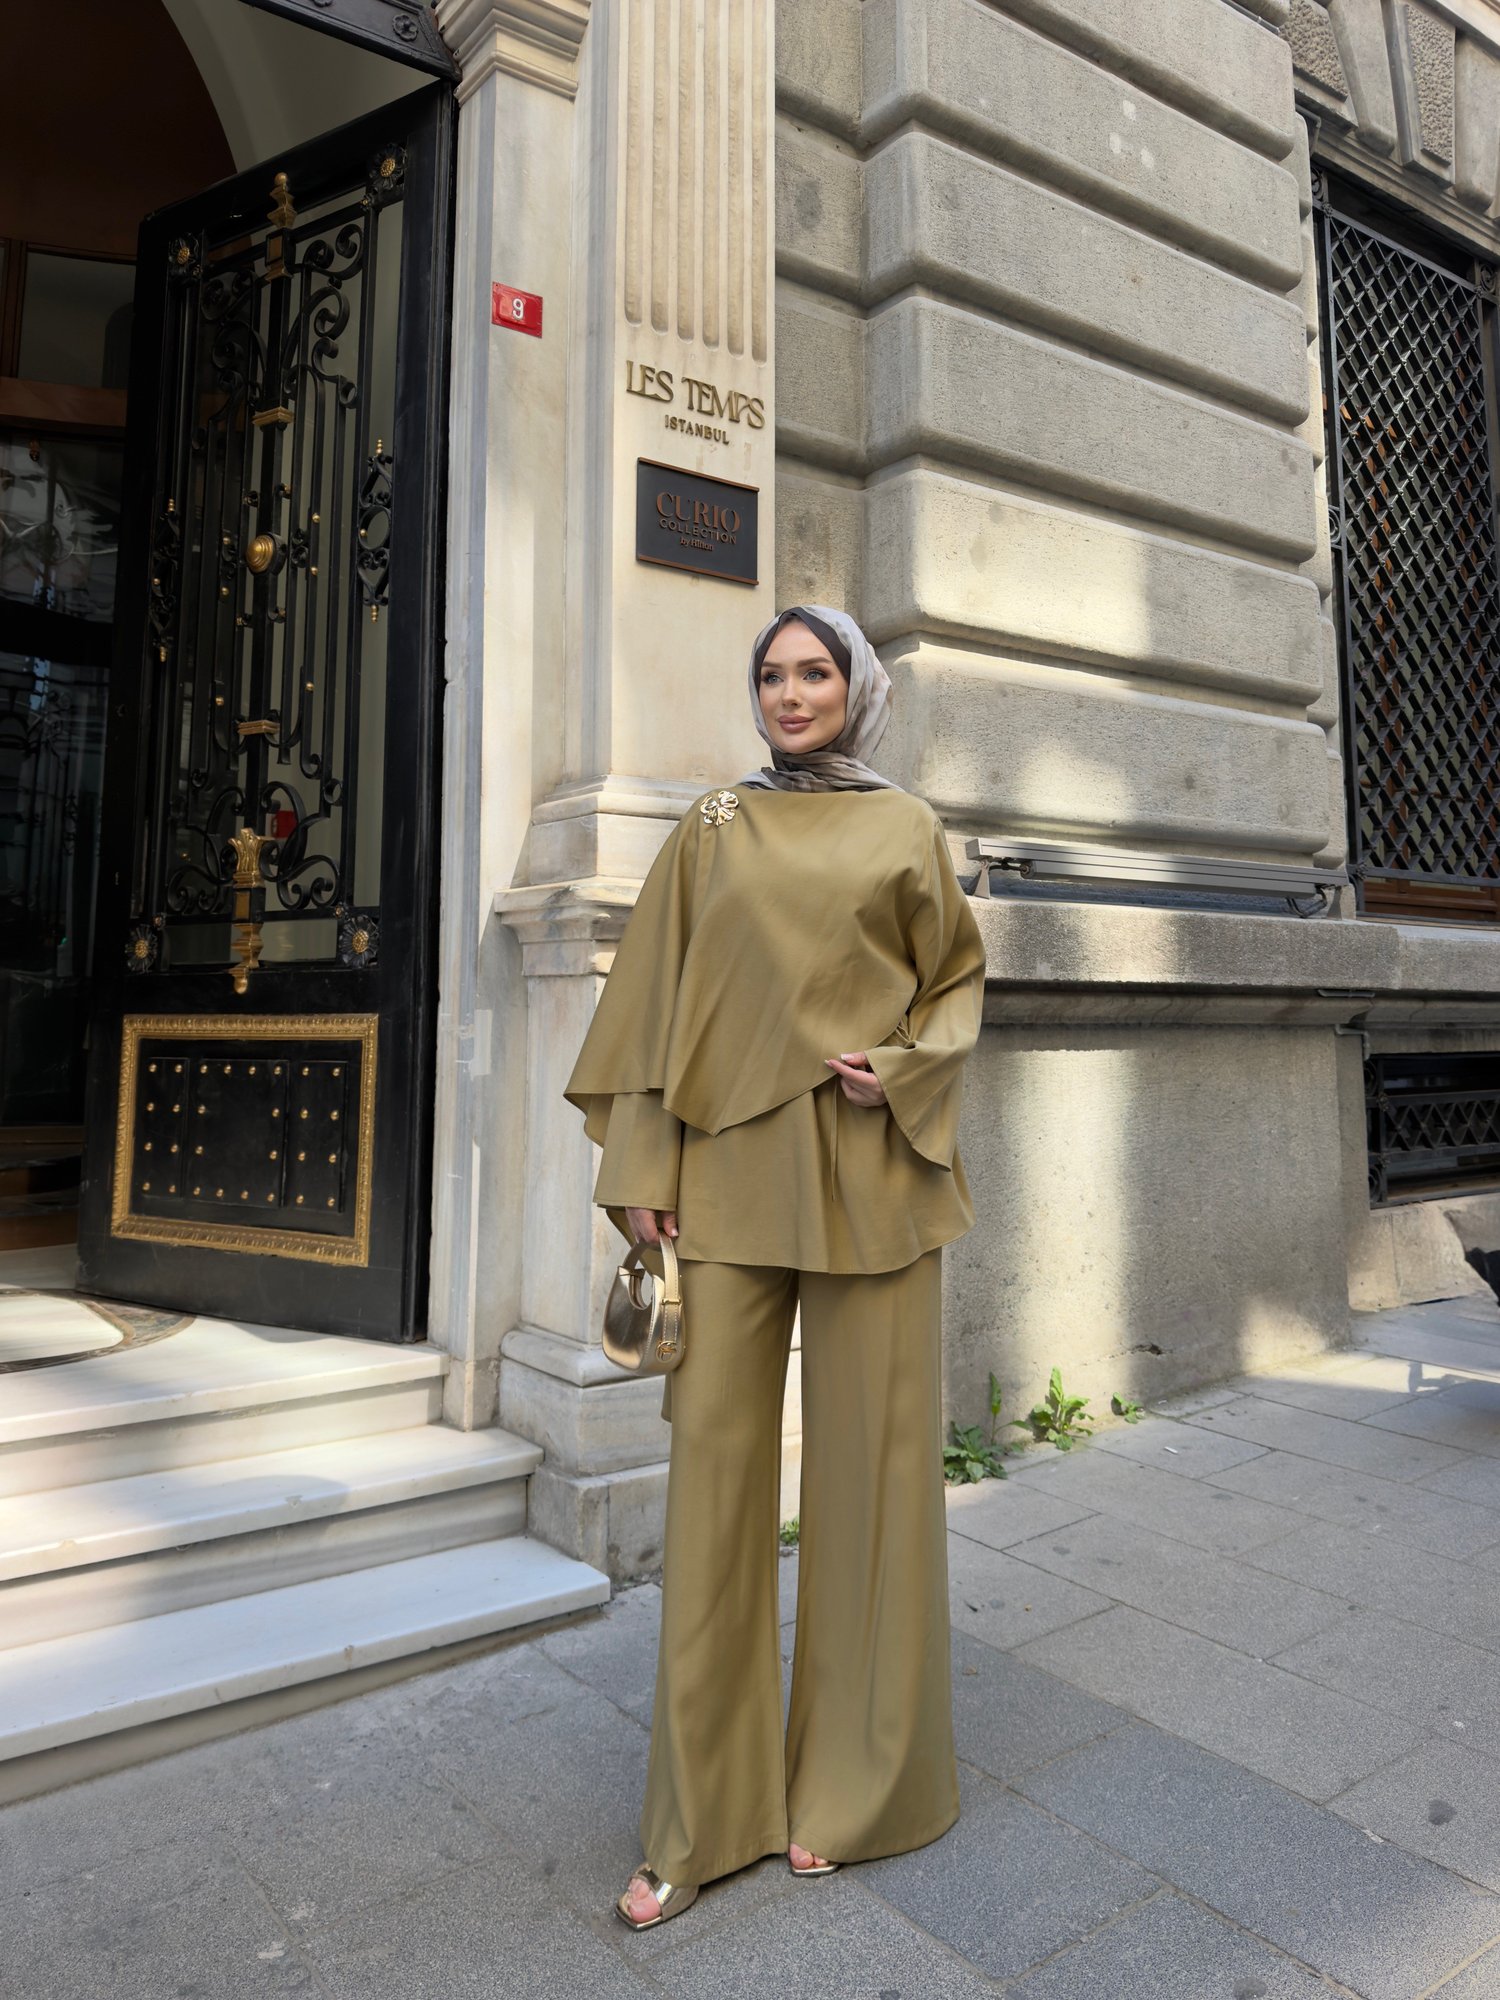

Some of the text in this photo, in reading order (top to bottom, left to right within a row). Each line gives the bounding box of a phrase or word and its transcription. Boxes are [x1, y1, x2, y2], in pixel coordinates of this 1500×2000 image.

[512, 297, 525, 321] 9
[626, 360, 765, 429] LES TEMPS
[664, 414, 730, 445] ISTANBUL
[656, 491, 741, 533] CURIO
[659, 518, 737, 544] COLLECTION
[680, 536, 691, 547] by
